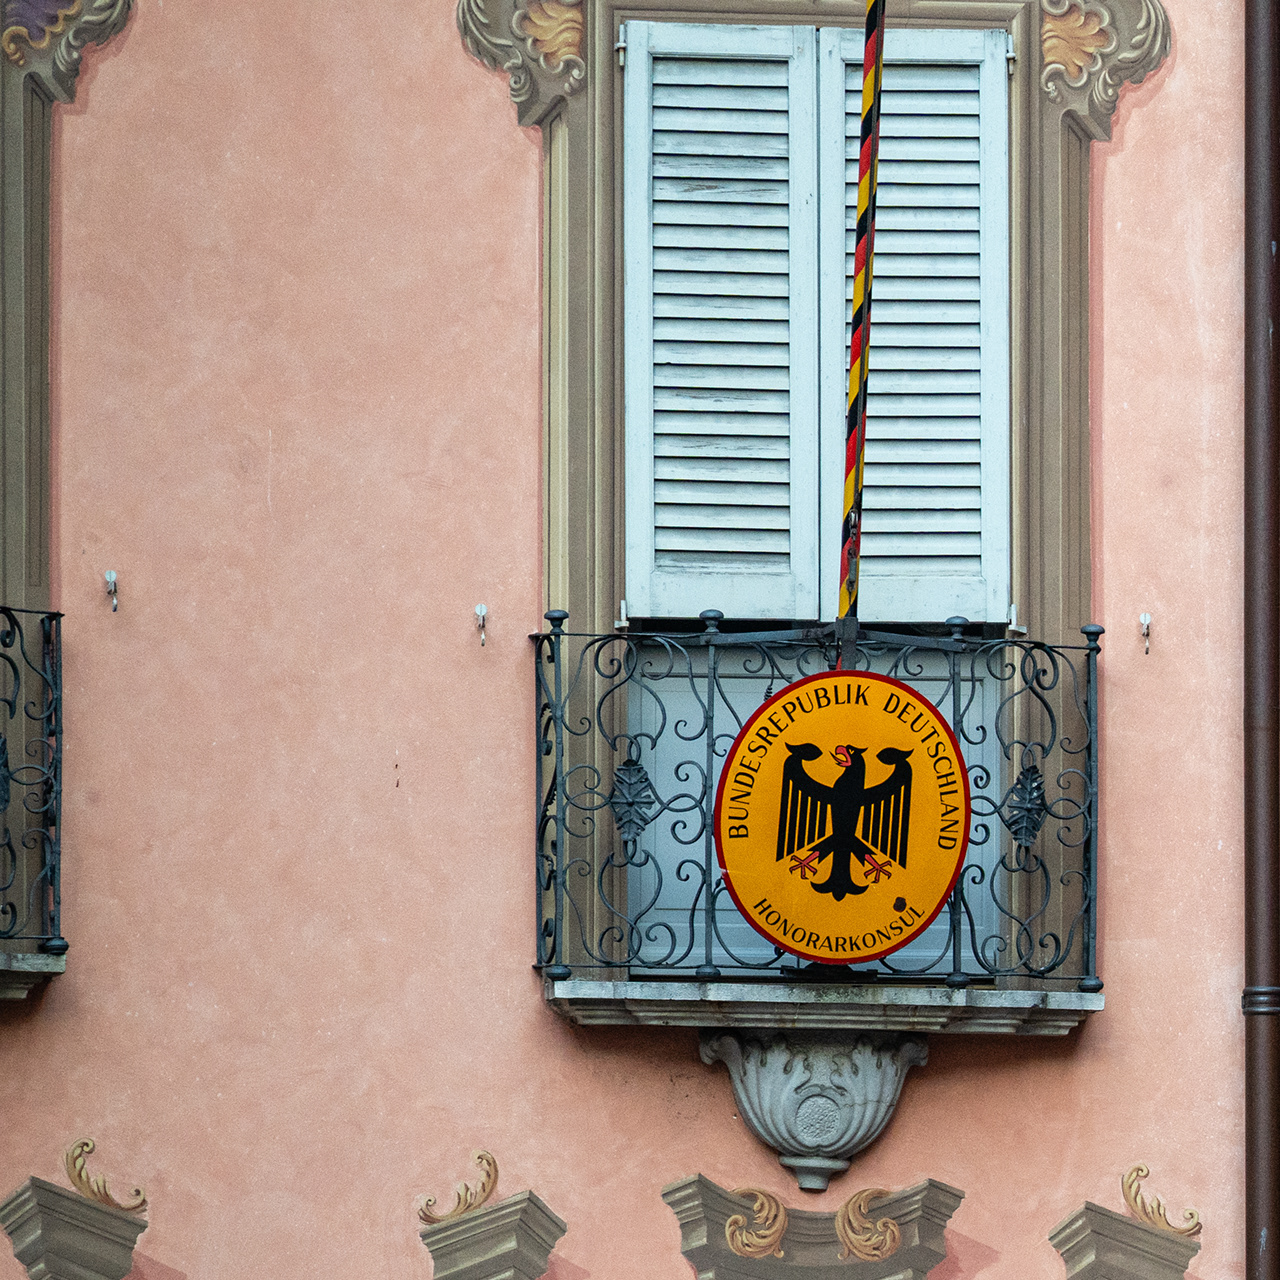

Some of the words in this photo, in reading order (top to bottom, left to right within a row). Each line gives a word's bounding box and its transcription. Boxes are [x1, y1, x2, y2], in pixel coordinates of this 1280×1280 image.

[728, 683, 870, 839] BUNDESREPUBLIK
[882, 692, 958, 850] DEUTSCHLAND
[753, 898, 925, 953] HONORARKONSUL
